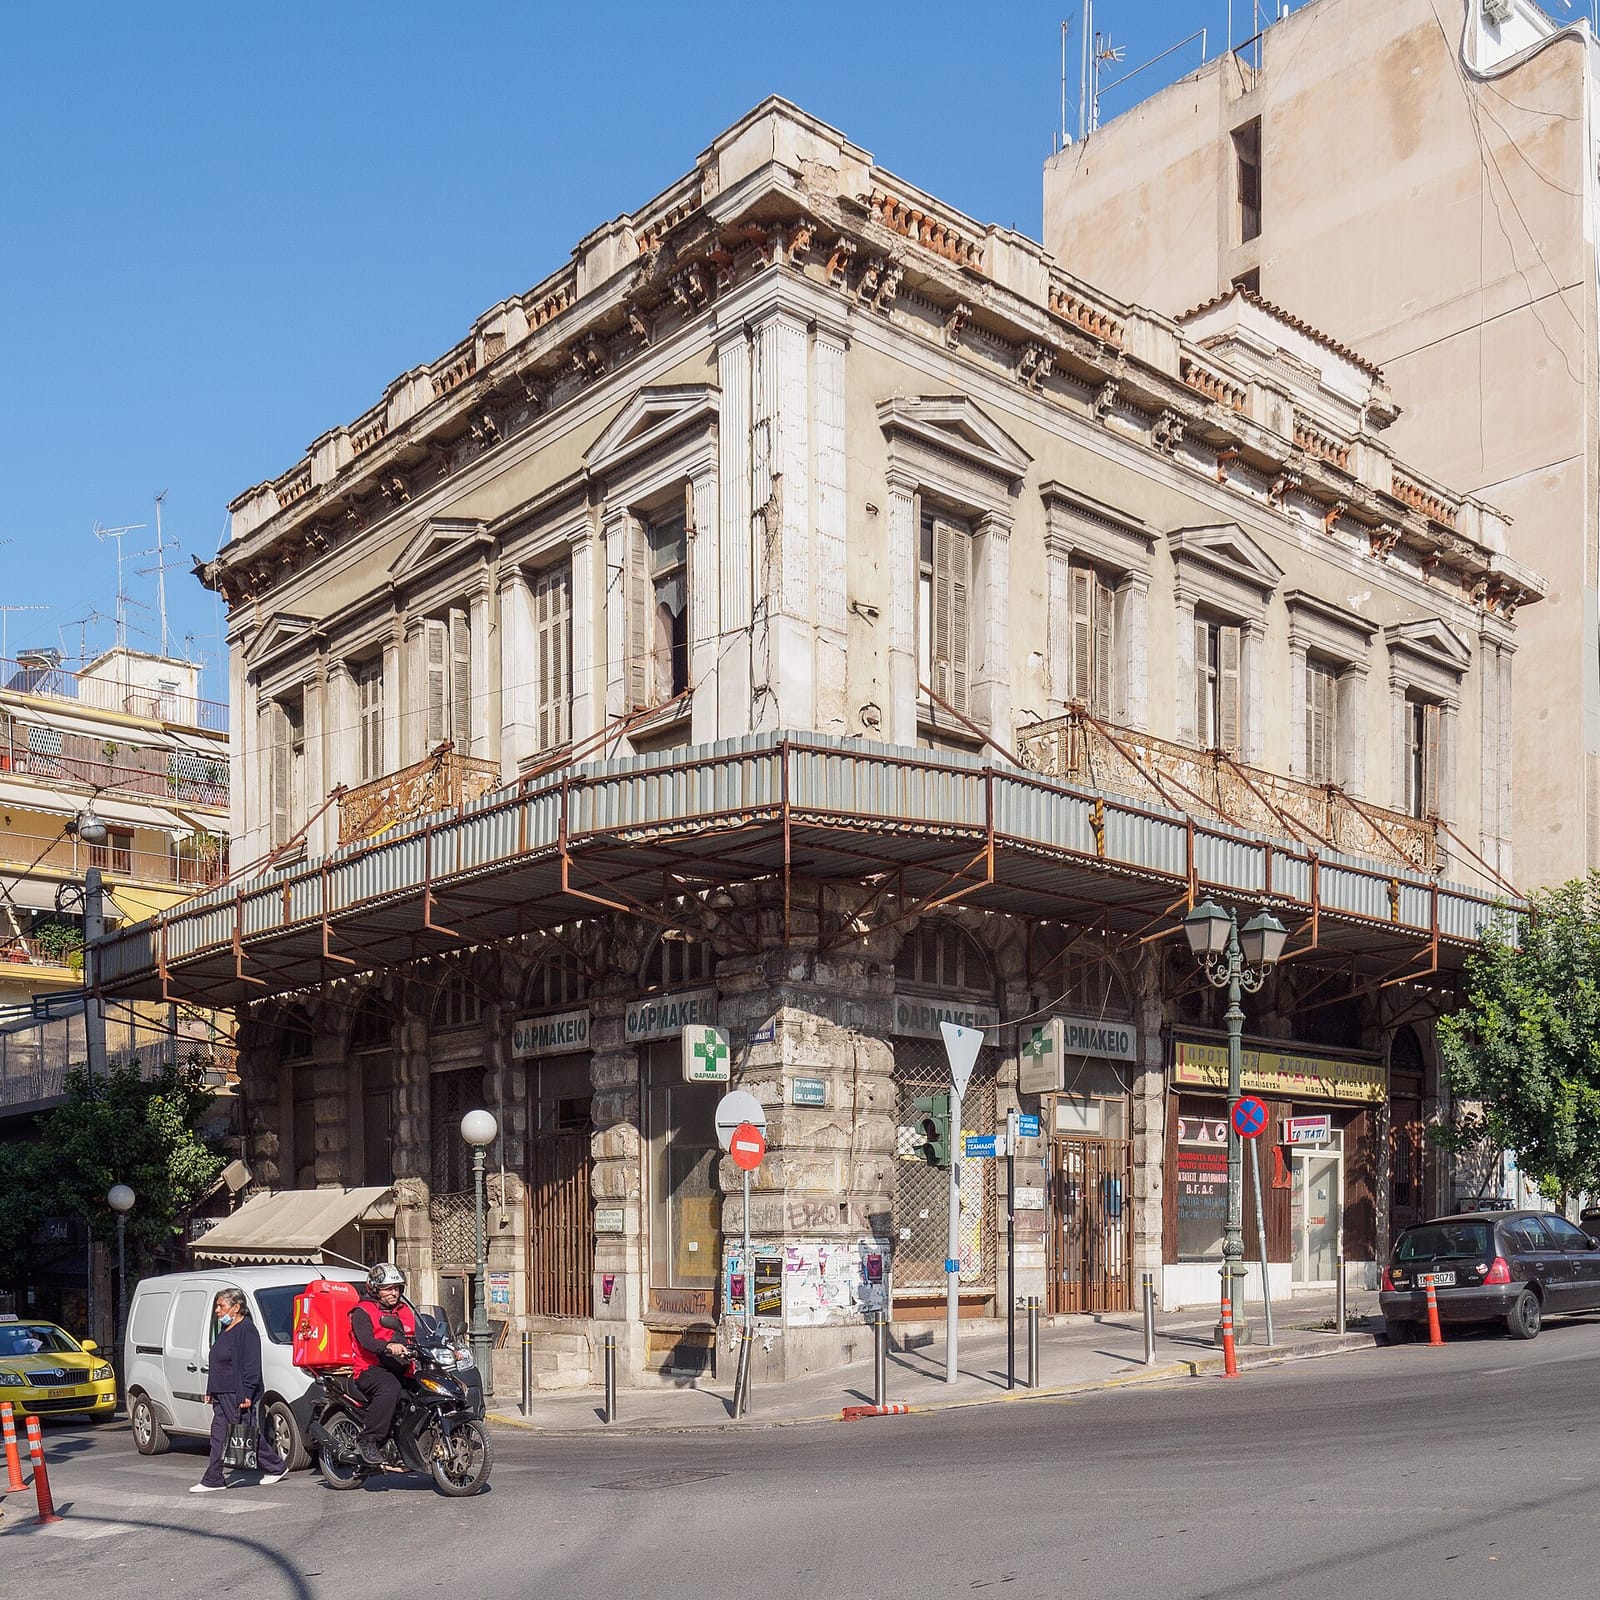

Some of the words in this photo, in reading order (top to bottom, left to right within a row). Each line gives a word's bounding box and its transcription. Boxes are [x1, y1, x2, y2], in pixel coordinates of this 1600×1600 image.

[514, 1017, 587, 1050] ΦΑΡΜΑΚΕΙΟ
[1062, 1024, 1129, 1054] ΑΡΜΑΚΕΙΟ
[694, 1072, 728, 1080] ΦΑΡΜΑΚΕΙΟ
[1304, 1130, 1325, 1139] ΠΑΠΙ
[1435, 1273, 1454, 1283] 9078
[231, 1436, 253, 1448] NYC
